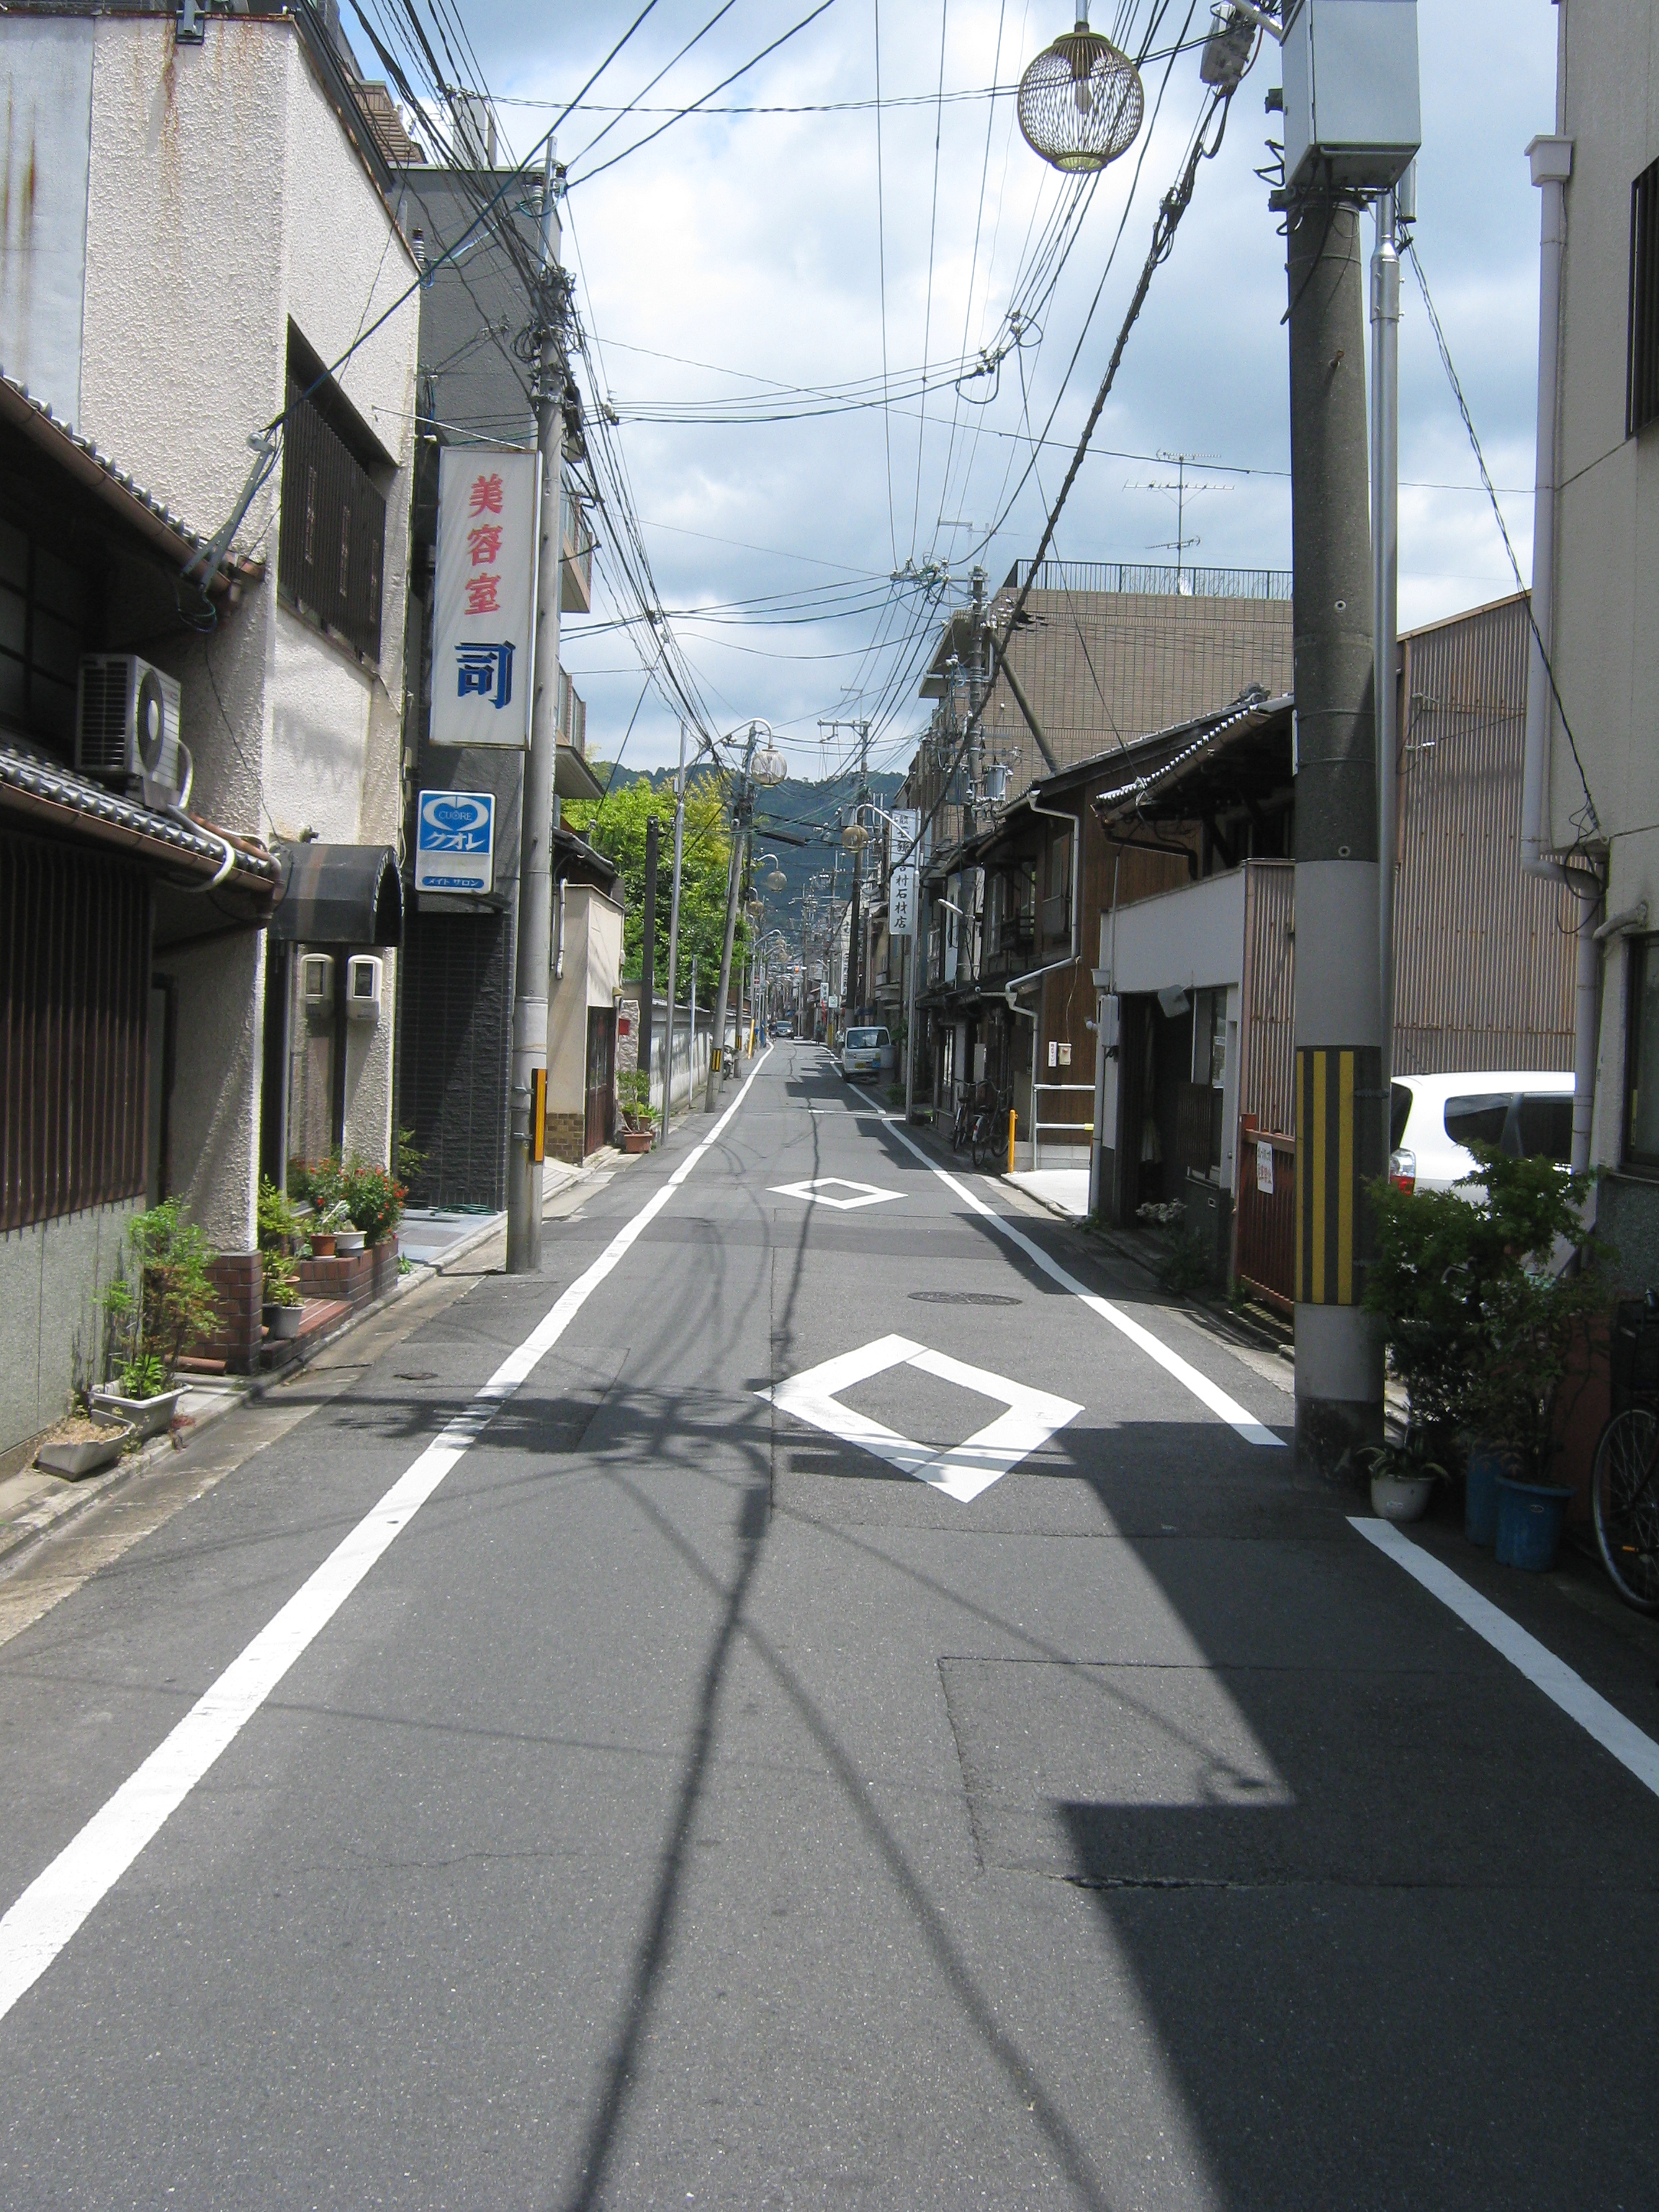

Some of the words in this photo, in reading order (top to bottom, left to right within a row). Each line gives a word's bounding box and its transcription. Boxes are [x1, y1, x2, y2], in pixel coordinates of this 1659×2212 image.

[465, 473, 503, 615] 美容室
[454, 640, 516, 709] 司
[439, 811, 472, 820] CUORE
[424, 832, 486, 850] クオレ
